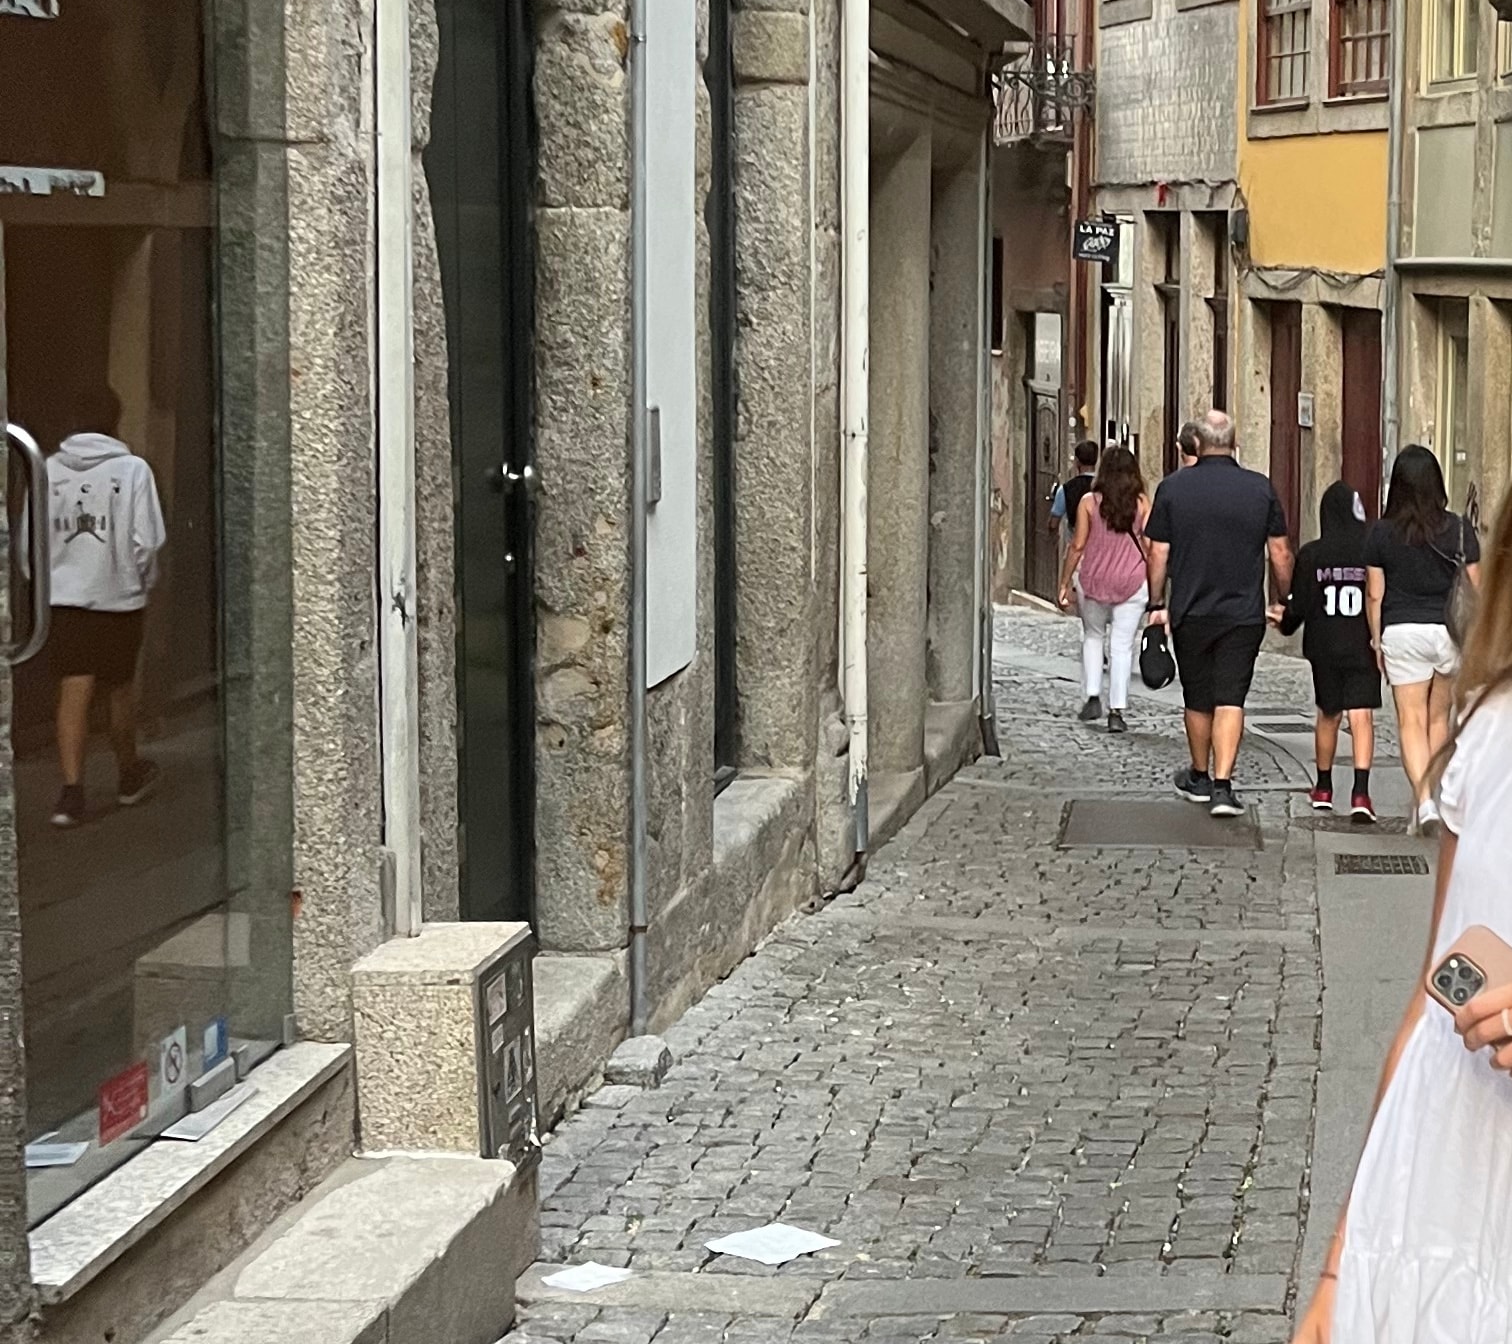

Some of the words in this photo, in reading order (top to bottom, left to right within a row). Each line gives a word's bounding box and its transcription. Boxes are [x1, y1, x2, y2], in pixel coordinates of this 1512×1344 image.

[1079, 224, 1093, 234] LA
[1095, 226, 1114, 237] PAZ
[1323, 585, 1363, 617] 10
